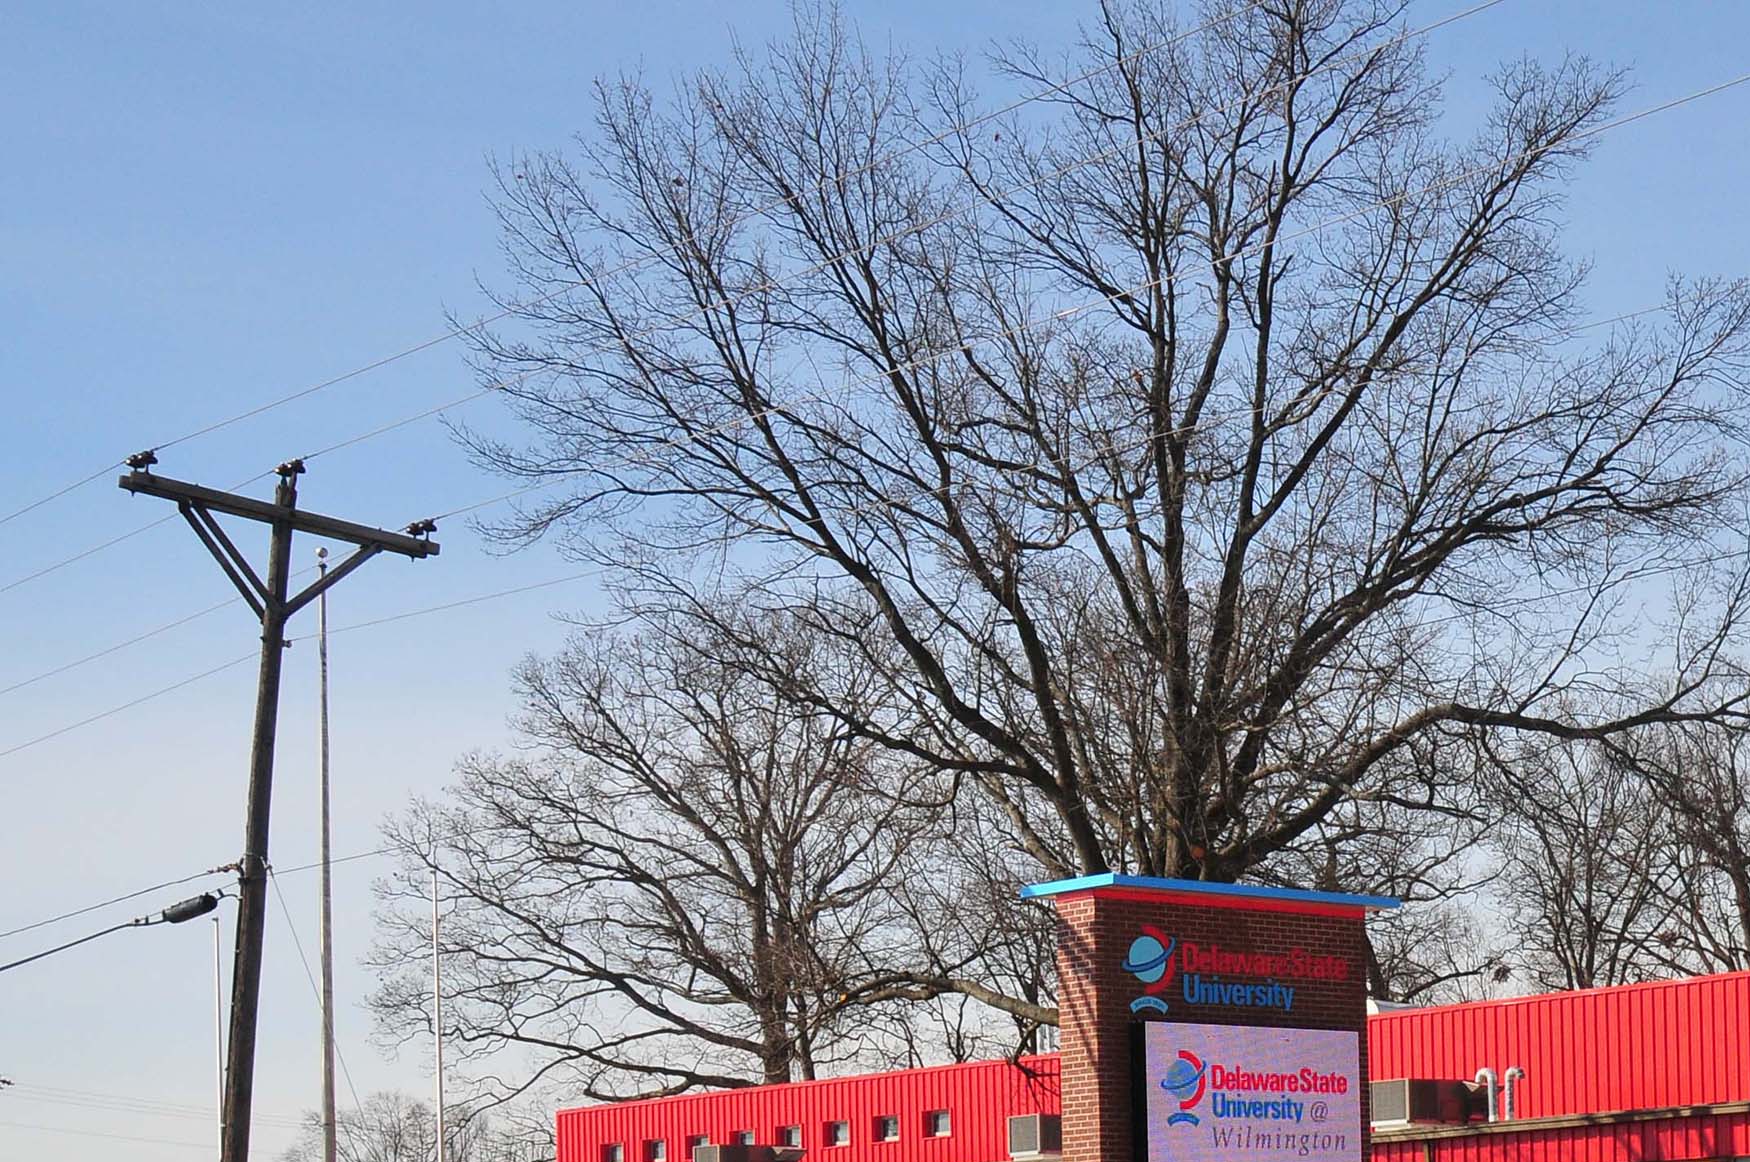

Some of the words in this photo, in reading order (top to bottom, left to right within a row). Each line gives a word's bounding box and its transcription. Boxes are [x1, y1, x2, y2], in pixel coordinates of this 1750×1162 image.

[1181, 942, 1289, 976] Delaware
[1289, 948, 1348, 980] State
[1183, 973, 1295, 1011] University
[1211, 1064, 1299, 1092] Delaware
[1299, 1067, 1348, 1094] State
[1212, 1092, 1303, 1123] University
[1310, 1101, 1328, 1122] @
[1212, 1126, 1346, 1156] Wilmington
